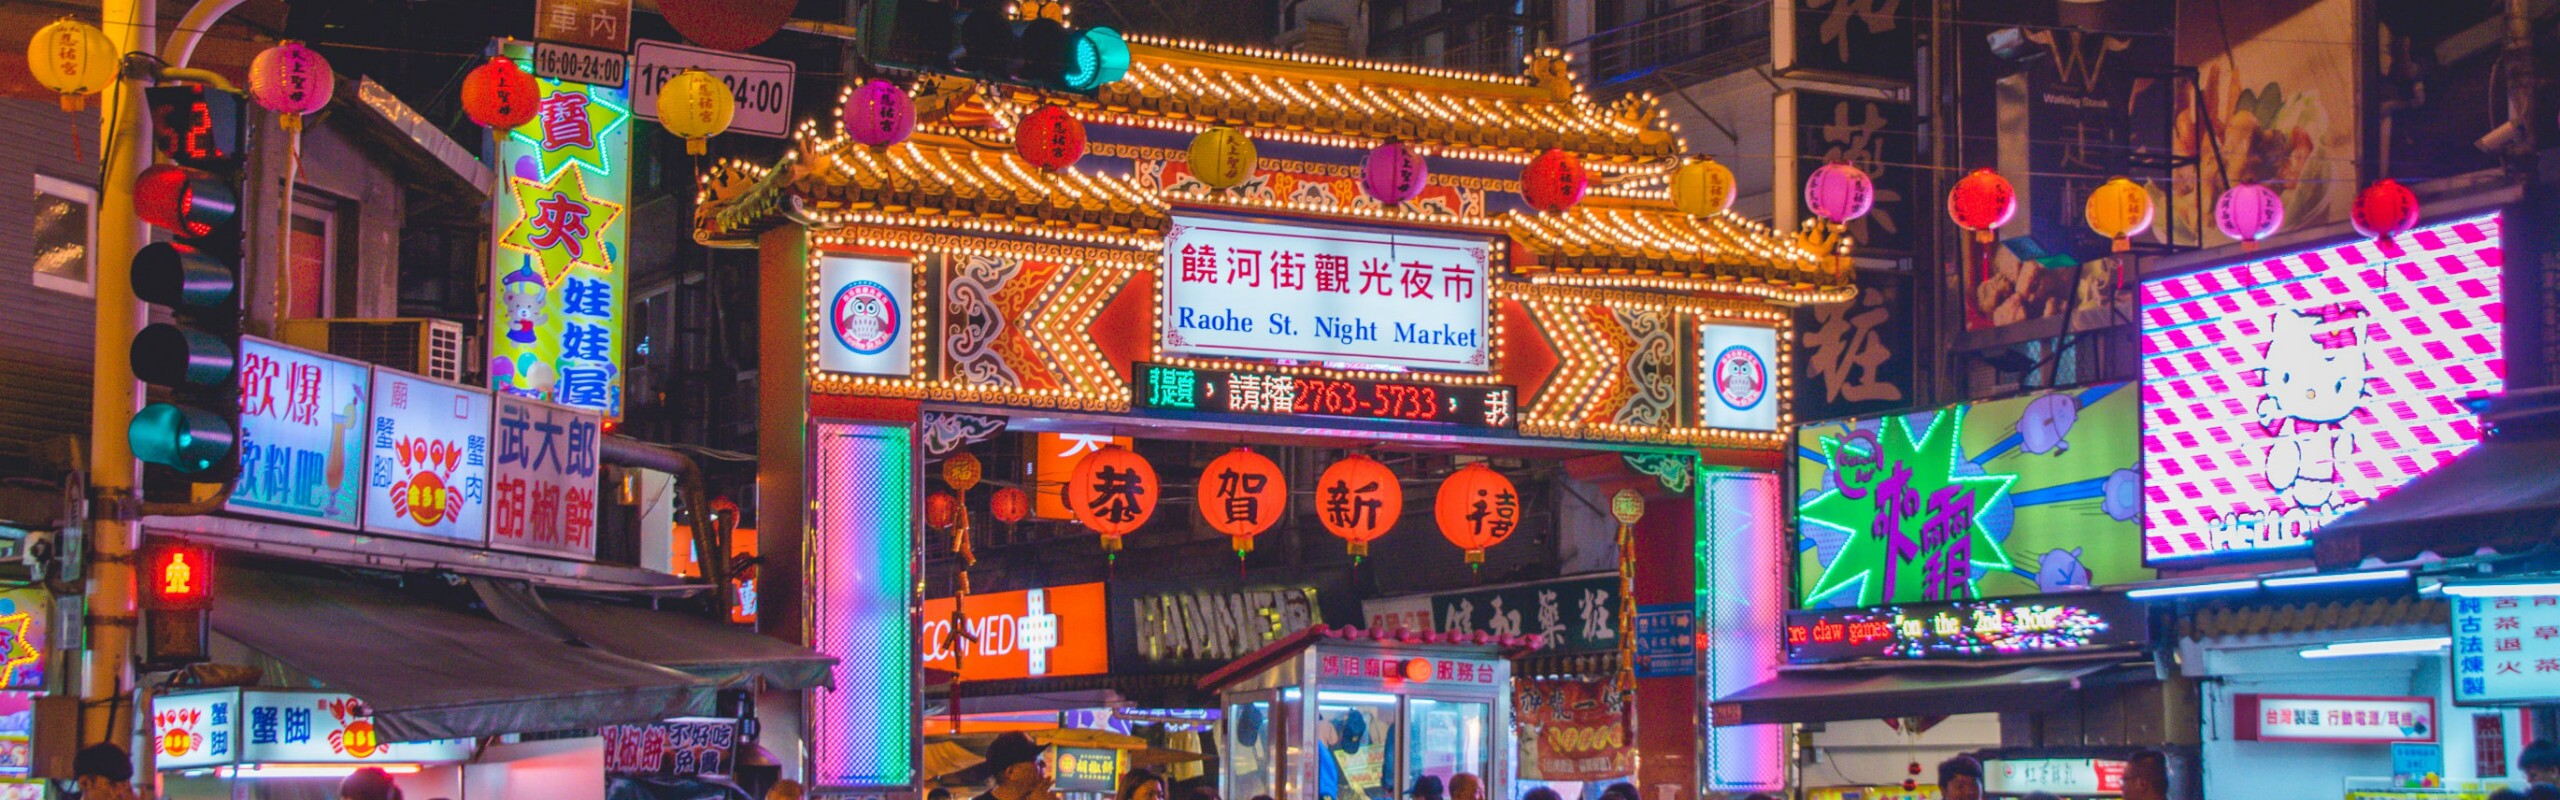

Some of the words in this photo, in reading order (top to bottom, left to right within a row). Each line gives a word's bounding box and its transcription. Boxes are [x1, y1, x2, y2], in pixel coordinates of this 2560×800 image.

[540, 50, 620, 83] 16:00-24:00
[1180, 243, 1475, 302] 饒河街觀光夜市
[559, 276, 612, 409] 娃娃屋
[1178, 306, 1253, 332] Raohe
[1268, 312, 1298, 335] St.
[1314, 316, 1377, 345] Night
[1393, 321, 1477, 348] Market
[241, 352, 322, 427] 飲爆
[373, 416, 396, 489] 蟹腳
[464, 434, 486, 506] 蟹肉
[498, 404, 596, 479] 武大郎
[496, 473, 594, 549] 胡椒餅
[923, 613, 1016, 661] COMED
[1812, 619, 1843, 642] claw
[1849, 621, 1891, 645] games
[1934, 613, 1961, 635] the
[1973, 608, 2002, 633] 2nd
[1436, 660, 1494, 684] 服務台
[670, 724, 732, 749] 不好吃
